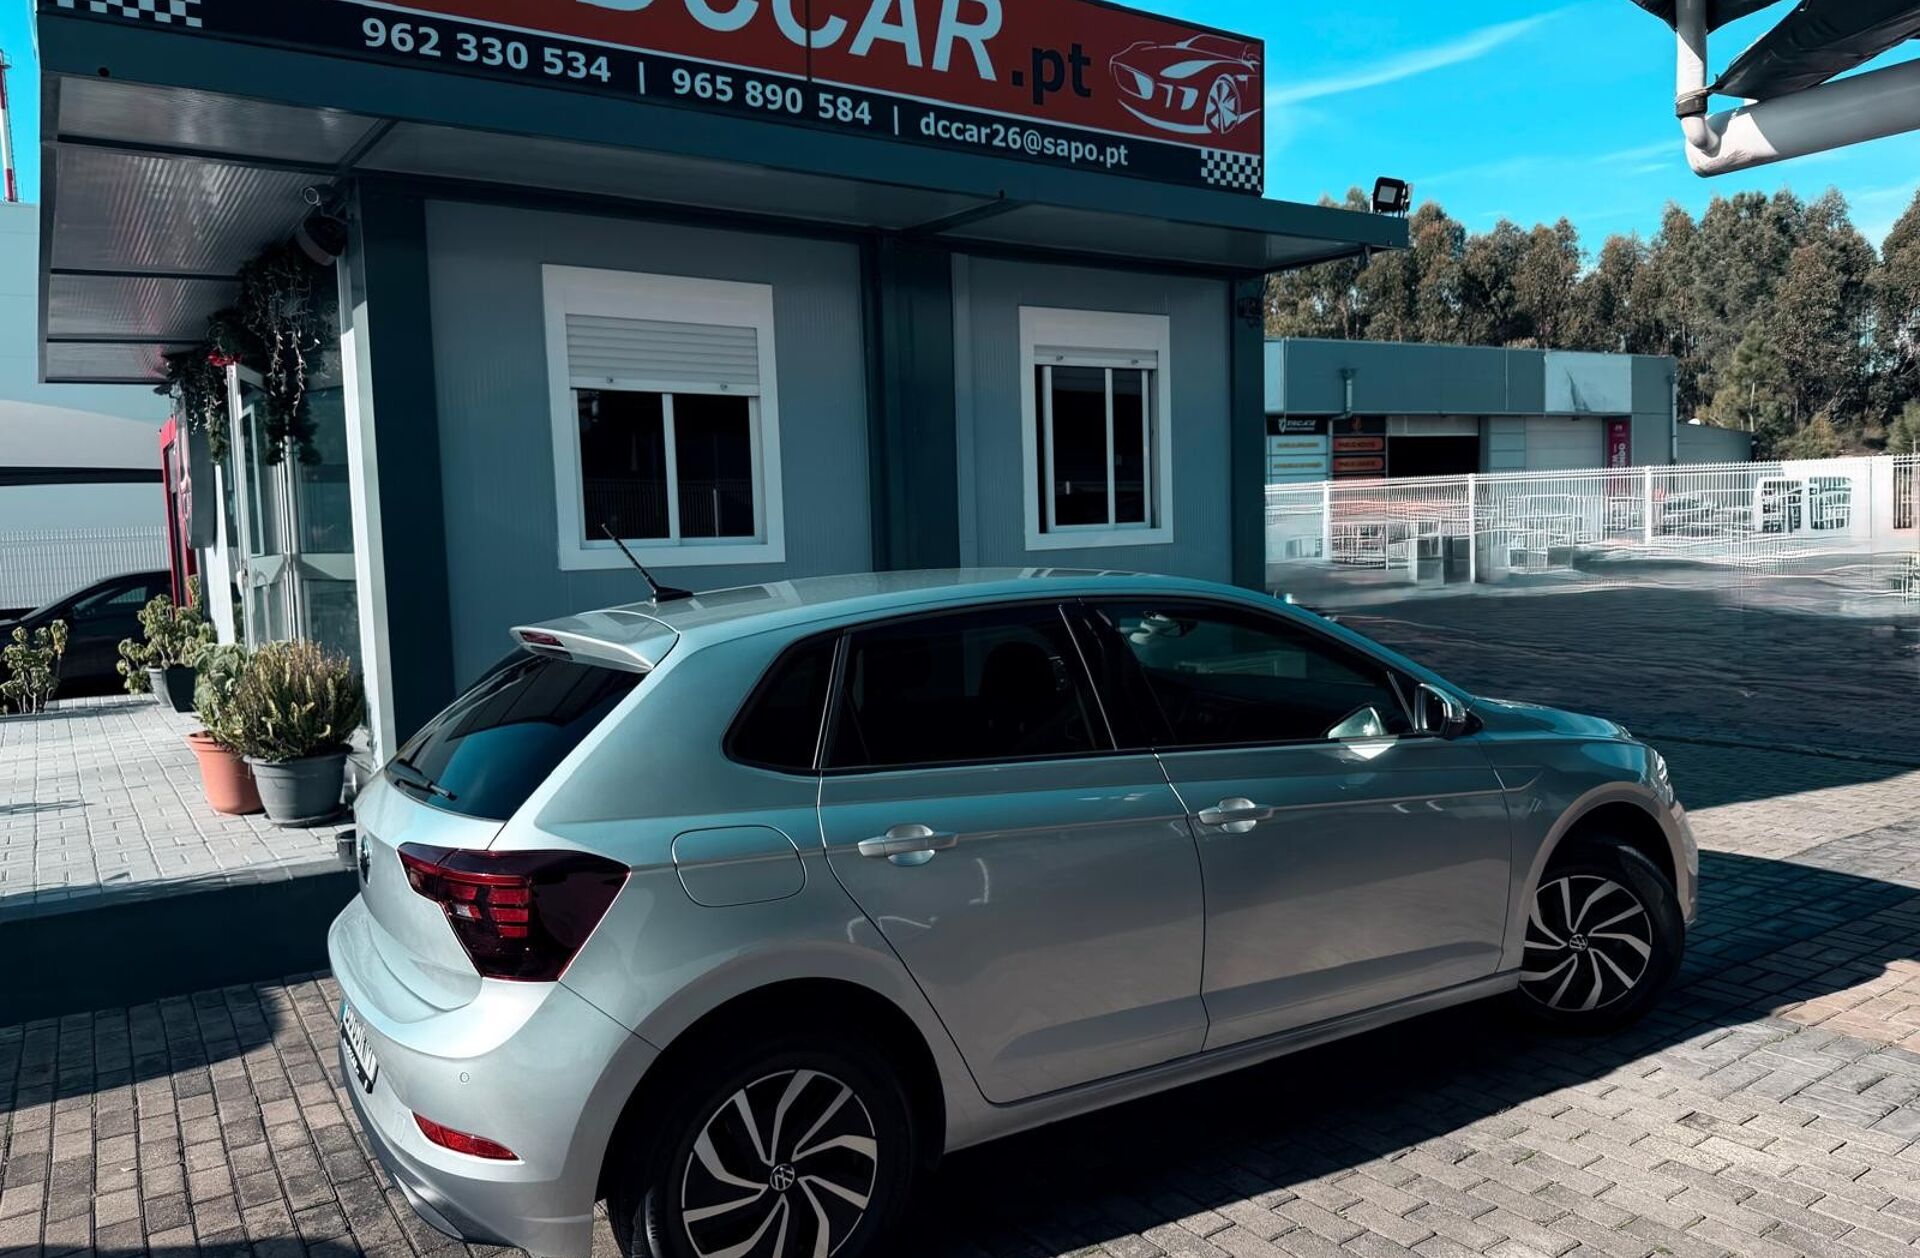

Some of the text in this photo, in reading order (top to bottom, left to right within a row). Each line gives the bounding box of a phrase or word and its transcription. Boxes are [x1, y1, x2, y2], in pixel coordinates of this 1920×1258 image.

[362, 18, 441, 57] 962
[456, 33, 529, 69] 330
[543, 47, 611, 82] 534
[672, 68, 733, 102] 965
[745, 80, 803, 114] 890
[818, 93, 872, 125] 584
[920, 112, 1128, 168] dccar26@sapo.pt
